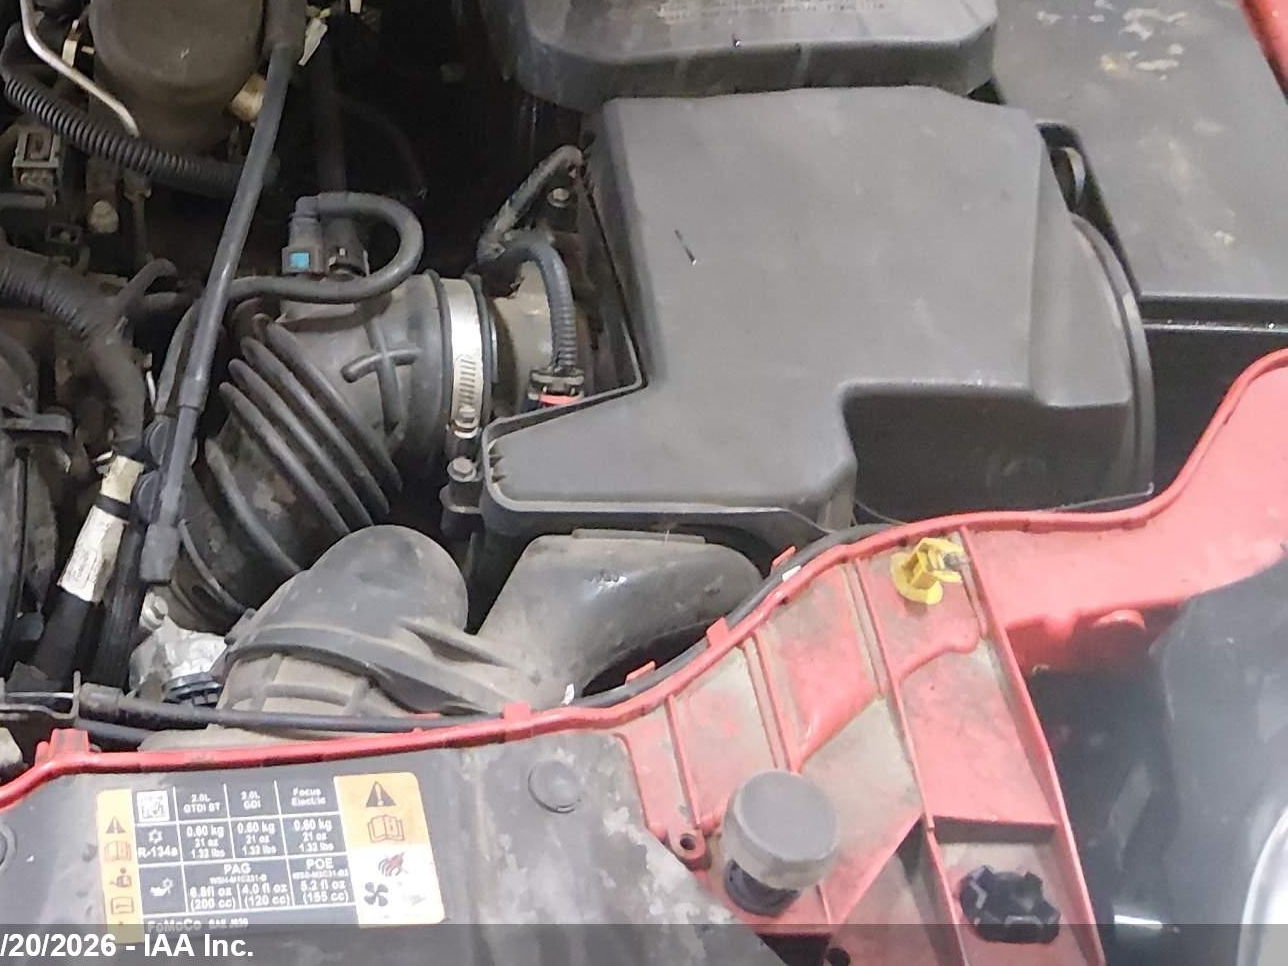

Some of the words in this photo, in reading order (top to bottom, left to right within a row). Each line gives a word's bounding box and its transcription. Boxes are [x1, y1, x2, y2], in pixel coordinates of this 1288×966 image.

[292, 786, 322, 796] Focus
[243, 800, 262, 810] GDI
[291, 796, 327, 807] Electric
[236, 821, 260, 834] 0.60
[261, 821, 276, 835] kg
[293, 818, 316, 832] 0.60
[317, 818, 333, 832] kg
[186, 825, 209, 838] 0.60
[210, 825, 225, 839] kg
[302, 832, 313, 842] 21
[315, 832, 328, 841] oz
[194, 838, 205, 848] 21
[207, 838, 219, 847] oz
[245, 834, 256, 845] 21
[258, 835, 270, 844] oz
[137, 845, 179, 859] R-134a
[262, 844, 277, 854] lbs
[319, 841, 335, 851] lbs
[211, 848, 226, 858] lbs
[223, 862, 252, 875] PAG
[305, 857, 334, 870] POE
[242, 883, 260, 894] 4.0
[273, 883, 288, 893] oz
[300, 879, 318, 892] 5.2
[331, 879, 346, 890] oz
[217, 887, 232, 897] oz
[302, 890, 329, 905] (155
[330, 889, 349, 903] cc)
[190, 897, 216, 912] (200
[218, 897, 236, 910] cc)
[244, 894, 270, 909] (120
[272, 893, 290, 906] cc)
[147, 918, 202, 933] FoMoCo
